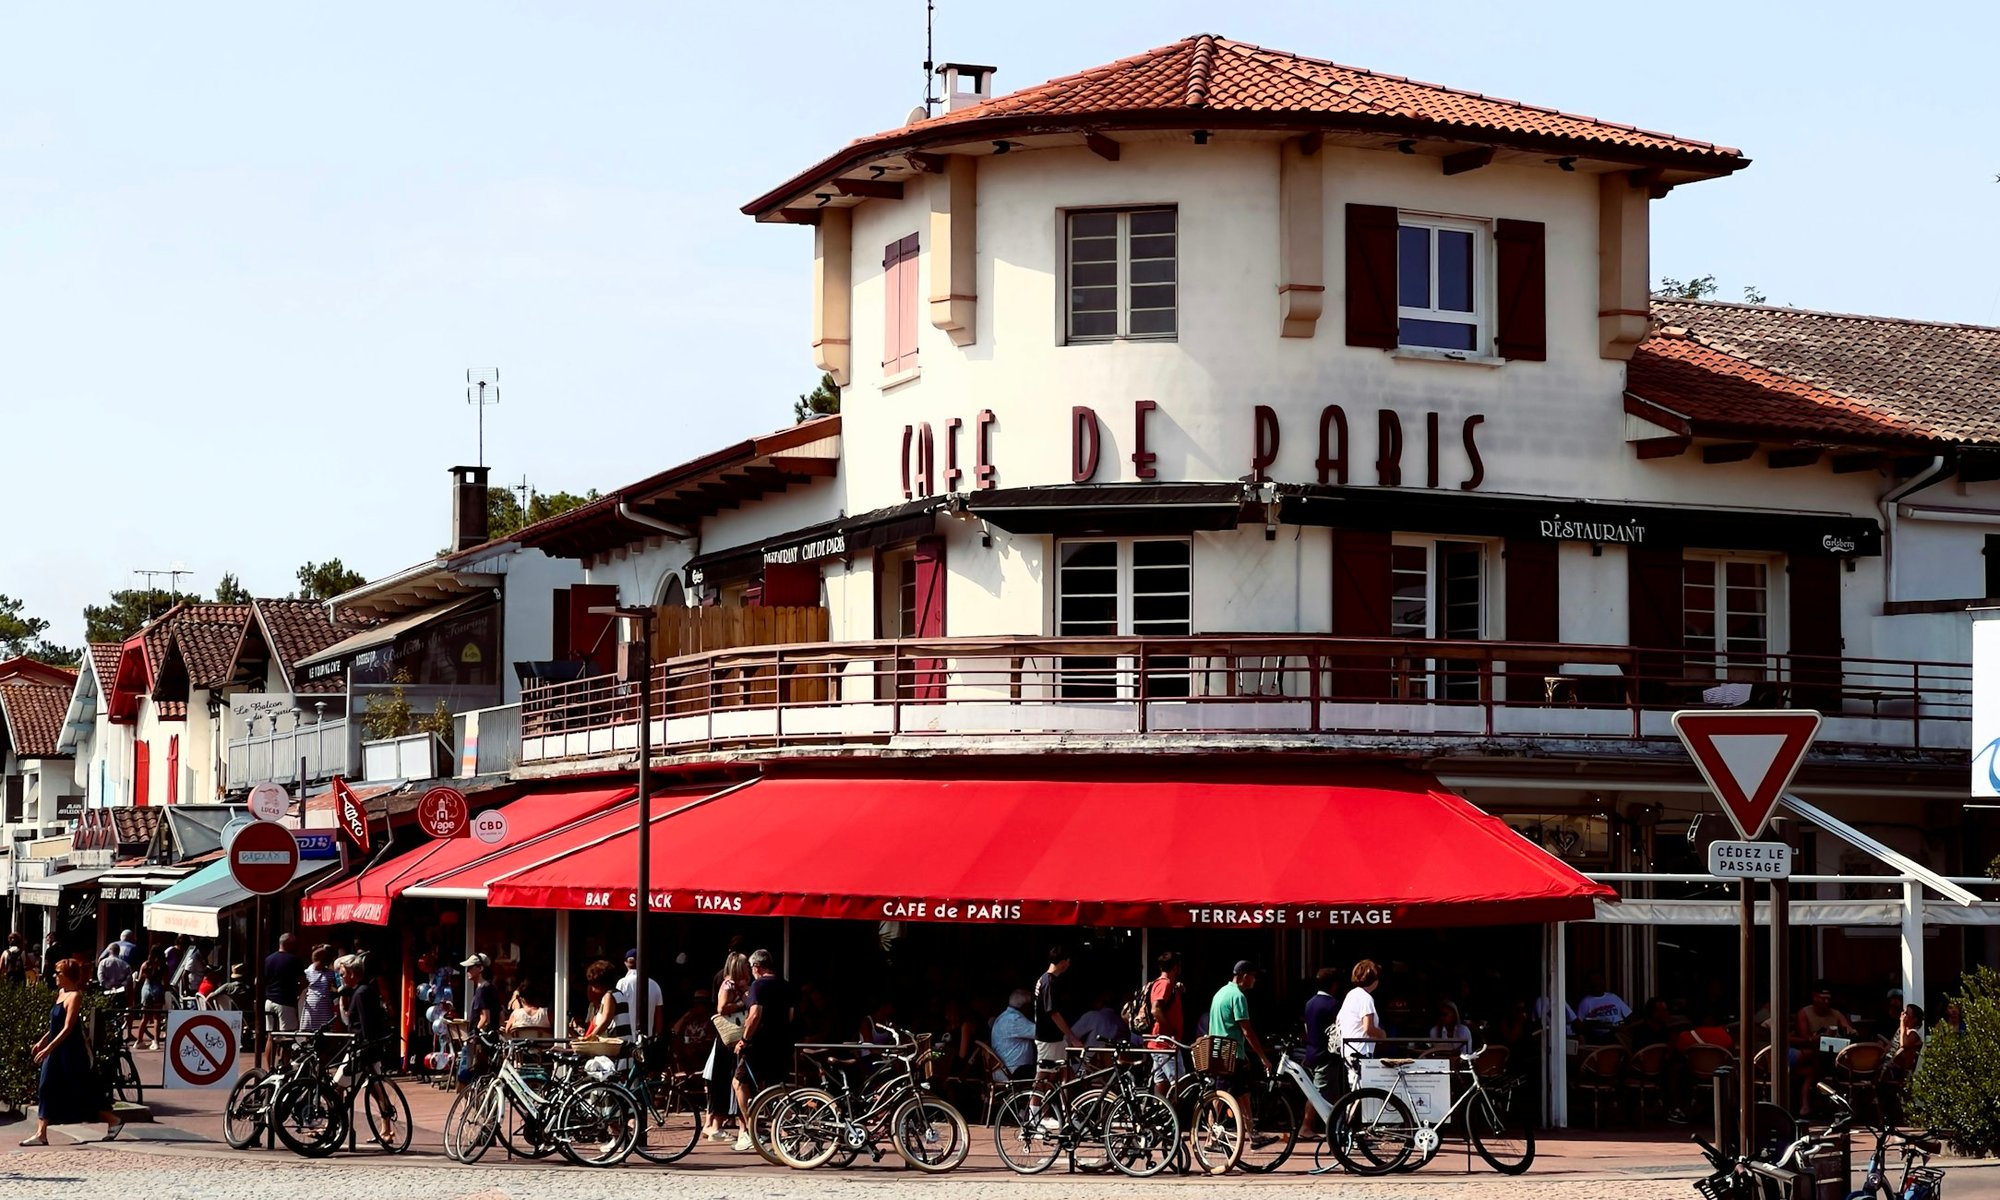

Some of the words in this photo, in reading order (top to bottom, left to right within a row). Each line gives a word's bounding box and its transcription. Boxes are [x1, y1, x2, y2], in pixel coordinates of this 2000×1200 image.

[1072, 400, 1157, 483] DE
[1250, 404, 1485, 490] PARIS
[1822, 534, 1855, 552] Carlsberg
[250, 700, 283, 711] Balcon
[261, 806, 280, 815] LUCAS
[339, 791, 364, 837] TABAC
[430, 820, 455, 832] Vape
[479, 820, 503, 831] CBD
[1717, 845, 1761, 859] CÉDEZ
[1769, 849, 1784, 860] LE
[1720, 860, 1781, 873] PASSAGE
[585, 892, 610, 906] BAR
[629, 892, 672, 908] SACK
[695, 895, 742, 911] TAPAS
[883, 902, 927, 917] CAFE
[934, 903, 959, 918] de
[967, 904, 1021, 919] PARIS
[1189, 909, 1286, 924] TERRASSE
[1296, 909, 1322, 924] 1er
[1329, 909, 1392, 924] ETAGE
